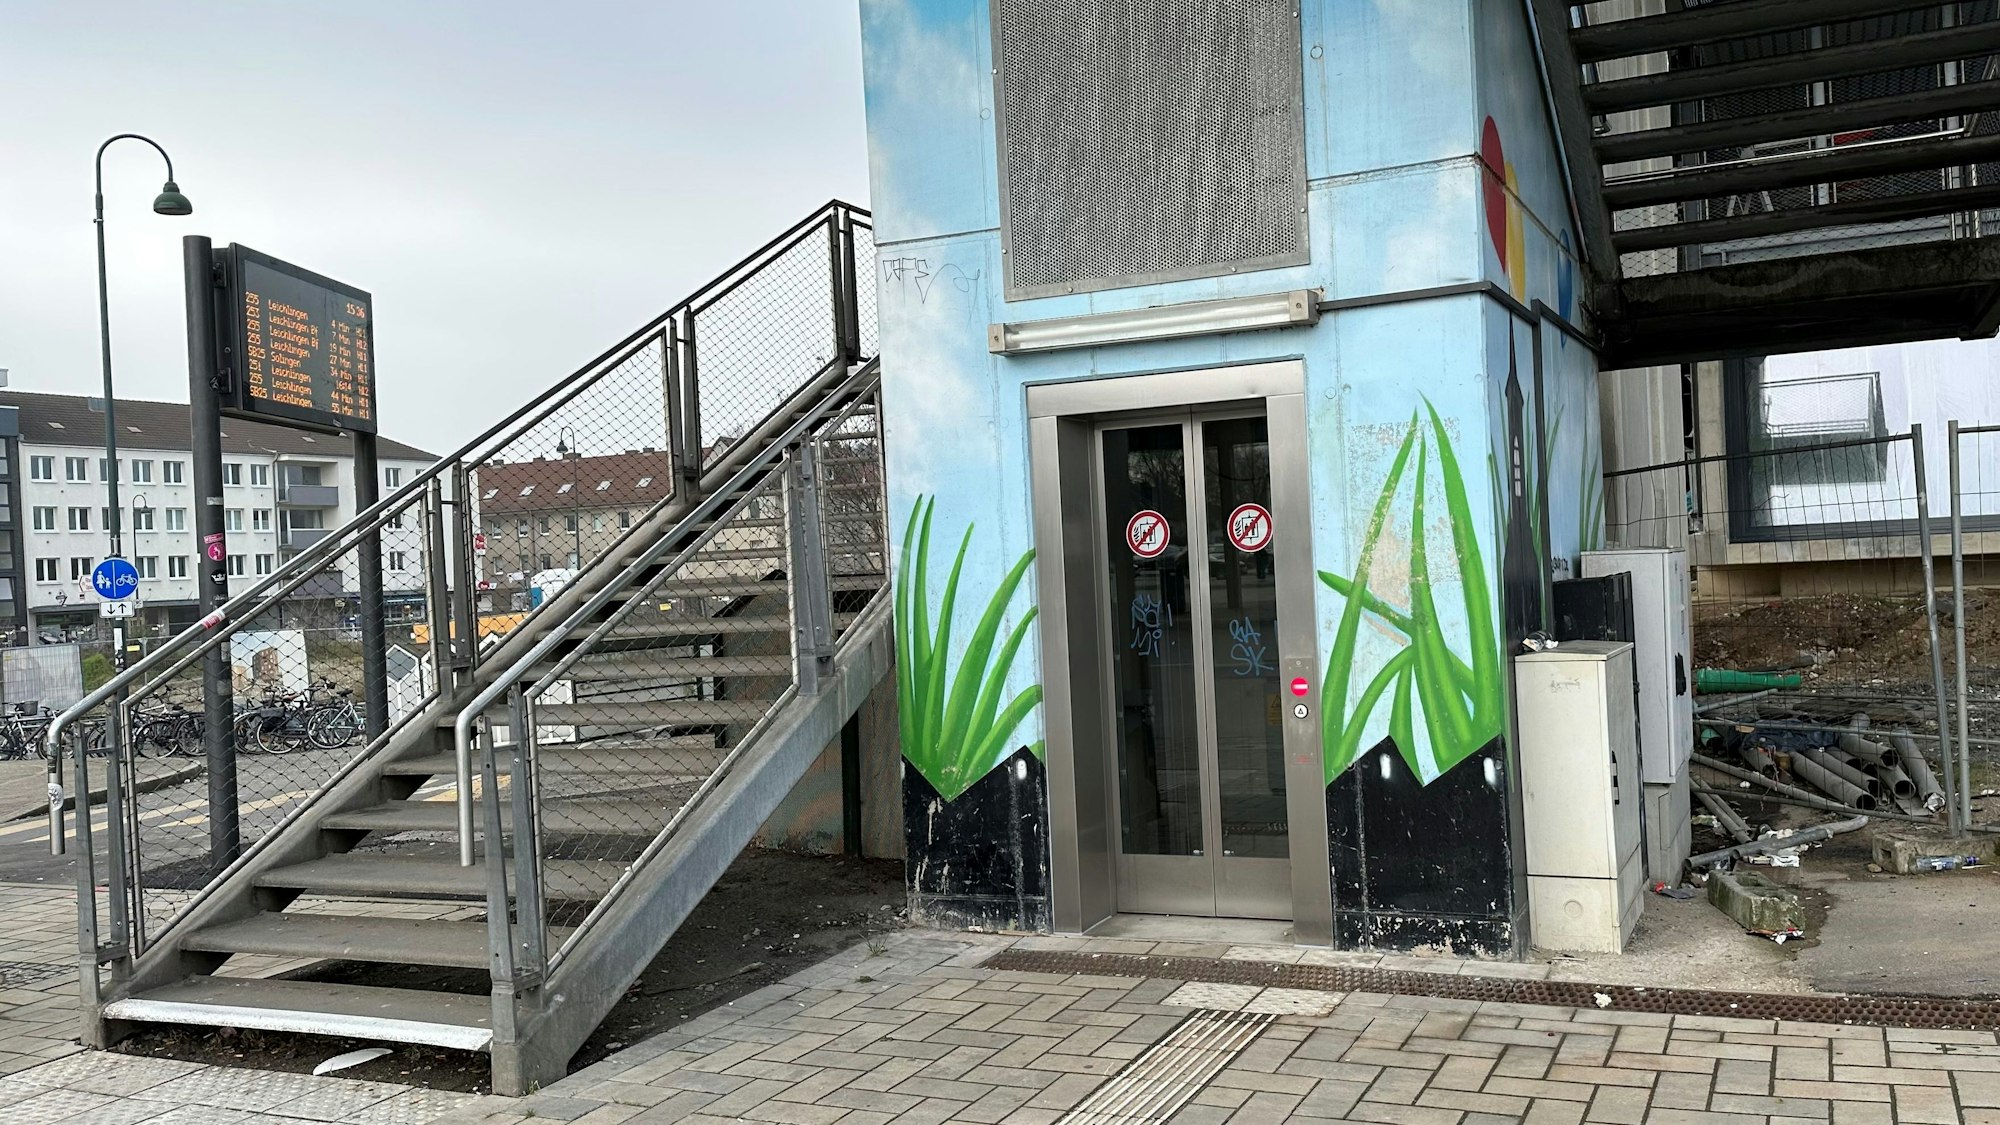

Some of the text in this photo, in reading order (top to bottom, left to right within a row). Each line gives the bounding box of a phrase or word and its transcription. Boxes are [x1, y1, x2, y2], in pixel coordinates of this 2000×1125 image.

[268, 299, 308, 320] Leichlingen
[269, 312, 309, 333] Leichlingen
[270, 325, 310, 345] Leichlingen
[270, 338, 310, 358] Leichlingen
[271, 352, 301, 368] Solingen
[272, 364, 312, 383] Leichlingen
[272, 377, 312, 396] Leichlingen
[272, 390, 312, 408] Leichlingen
